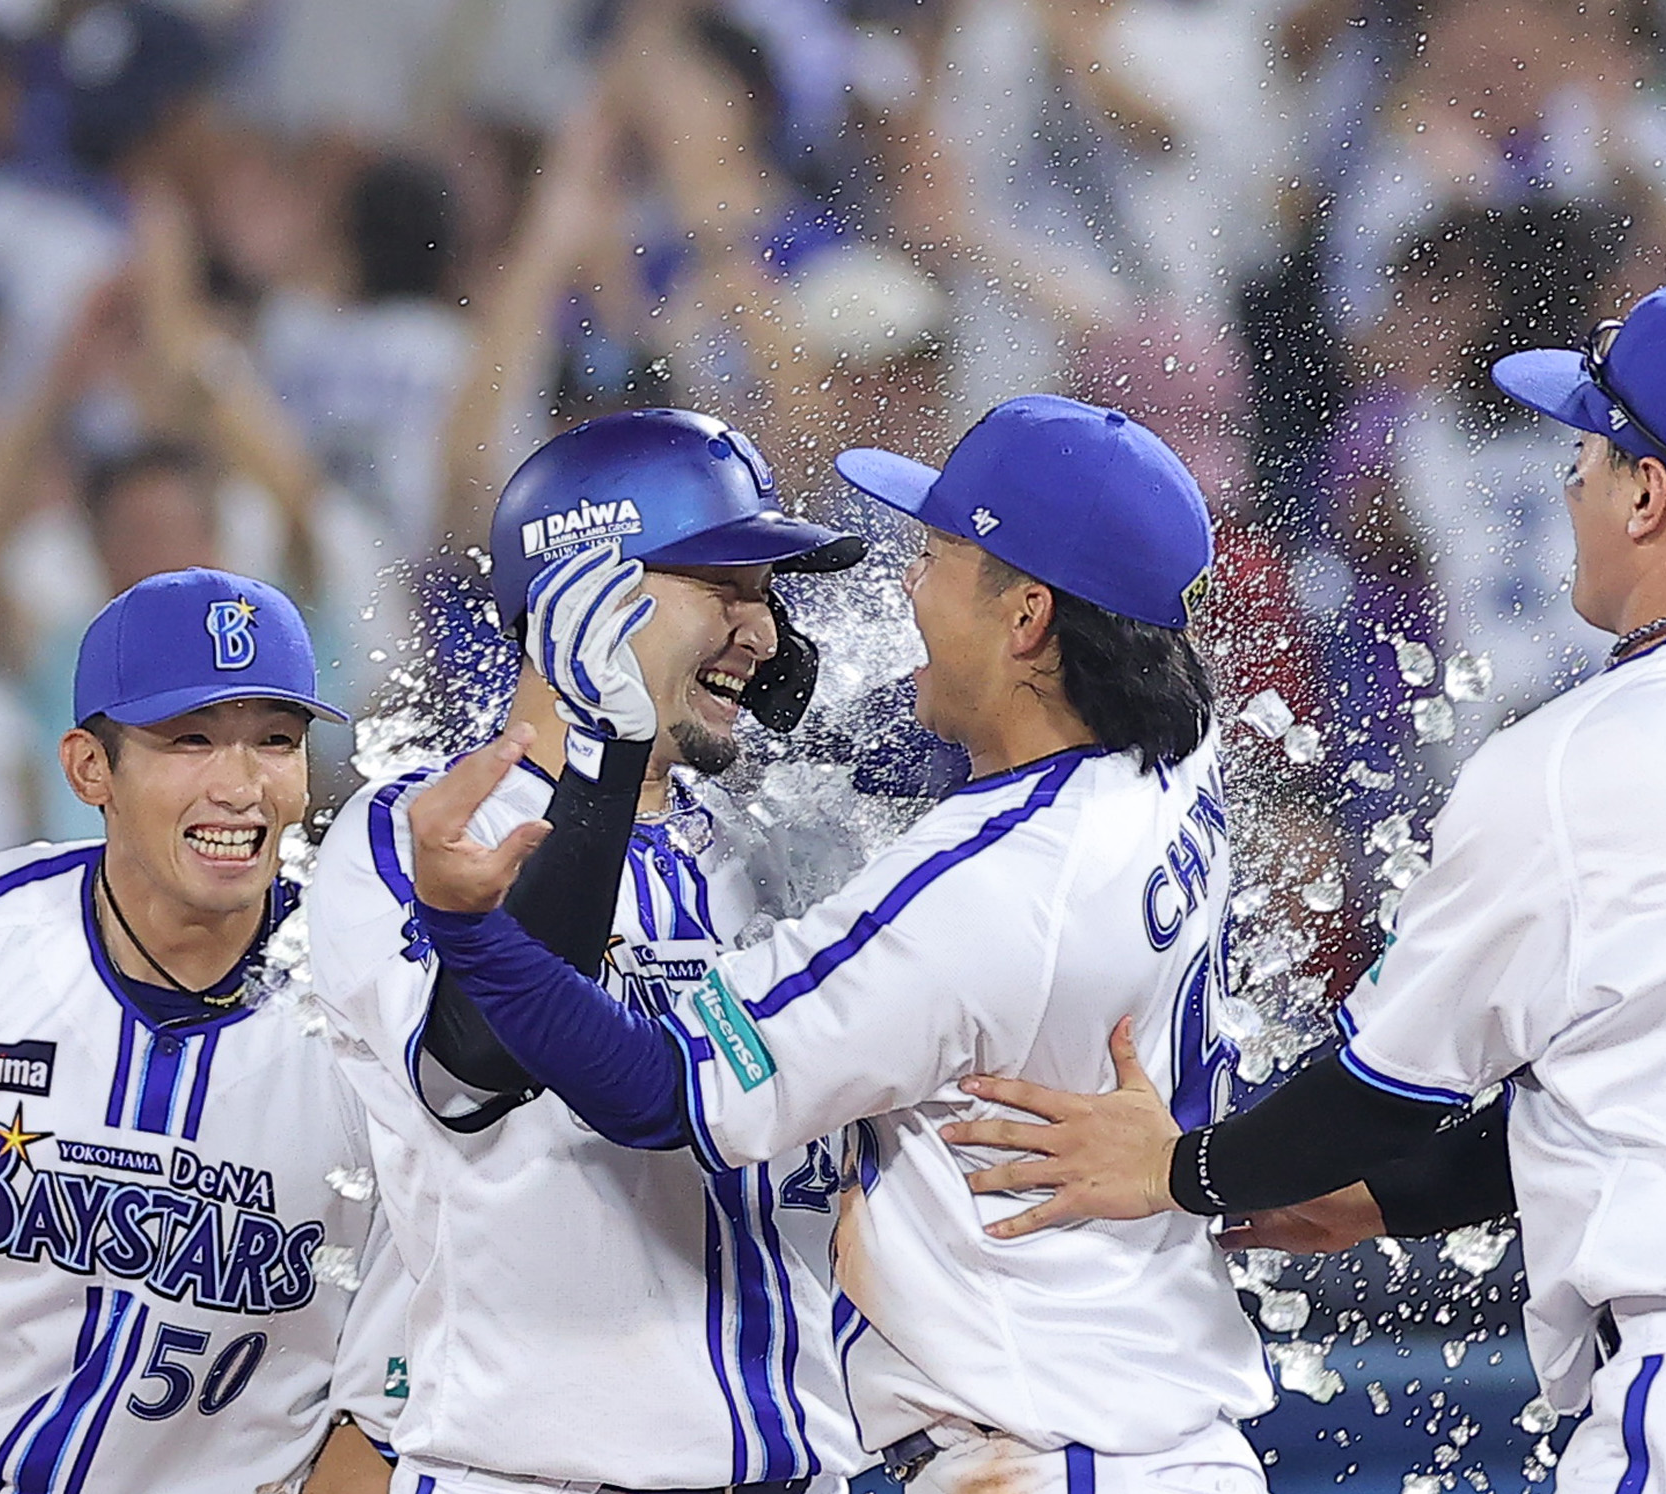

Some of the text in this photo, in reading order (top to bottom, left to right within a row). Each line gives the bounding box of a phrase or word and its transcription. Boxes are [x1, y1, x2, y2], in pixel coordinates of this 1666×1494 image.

[206, 600, 256, 671] B
[697, 977, 764, 1083] Hisense
[58, 1140, 274, 1213] YOKOHAMA DeNA
[126, 1322, 268, 1421] 50
